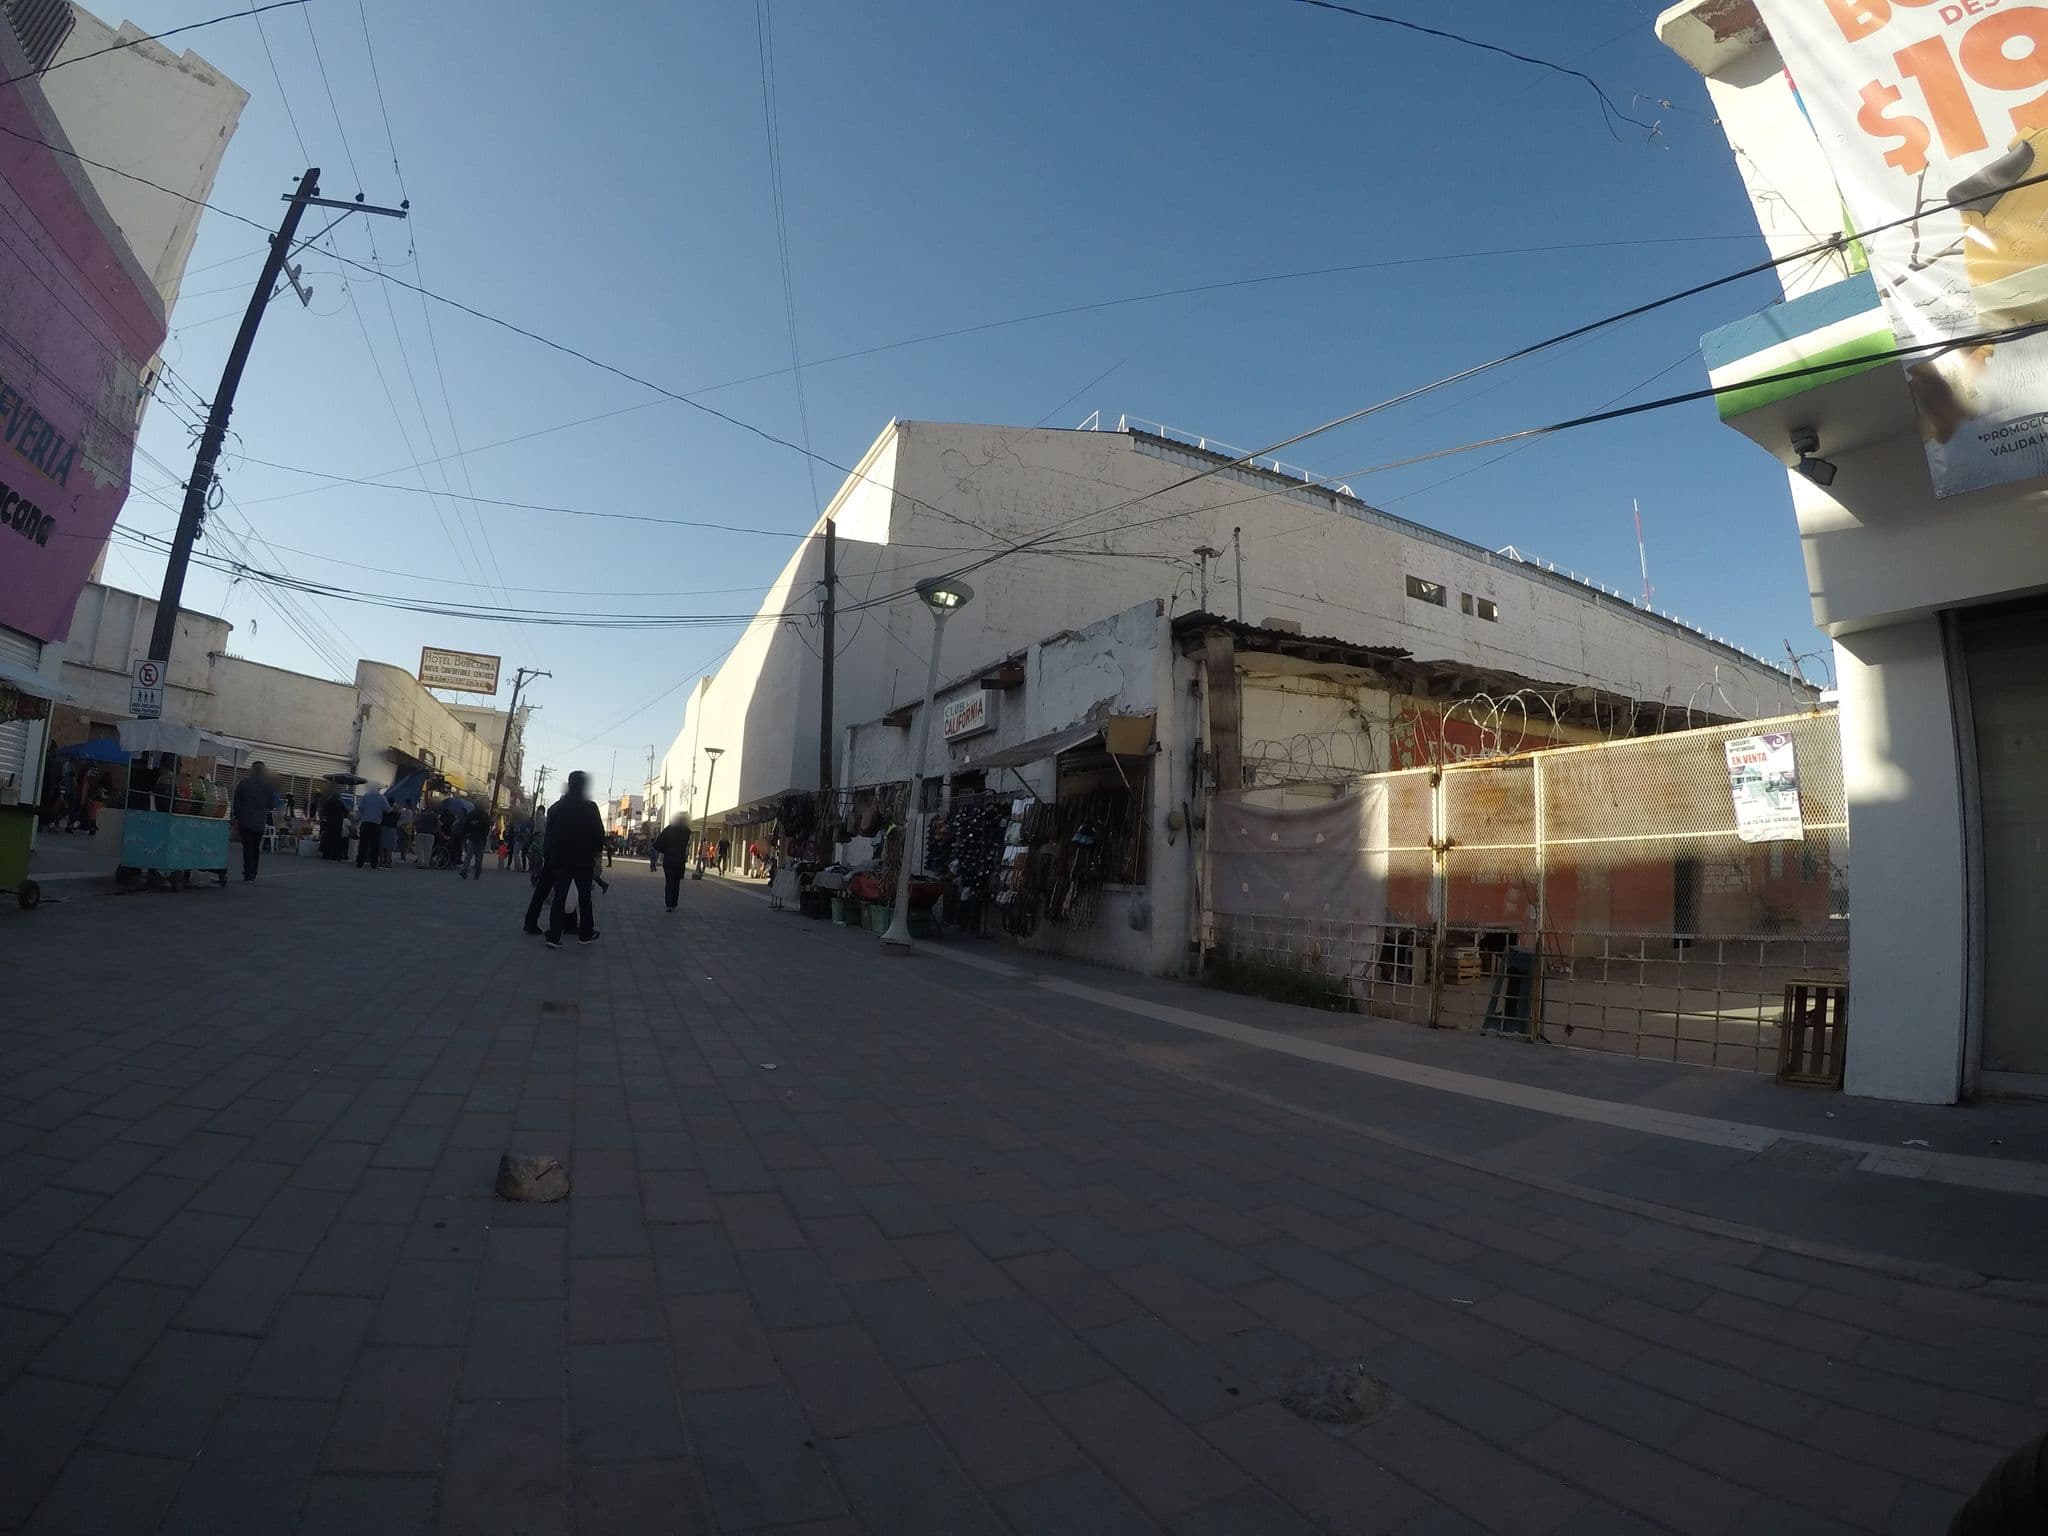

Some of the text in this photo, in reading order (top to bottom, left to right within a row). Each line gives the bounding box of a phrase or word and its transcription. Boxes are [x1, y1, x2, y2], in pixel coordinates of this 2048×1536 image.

[944, 697, 984, 736] CALIFORNIA
[945, 701, 965, 718] CLUB
[1732, 752, 1767, 766] EN VENTA
